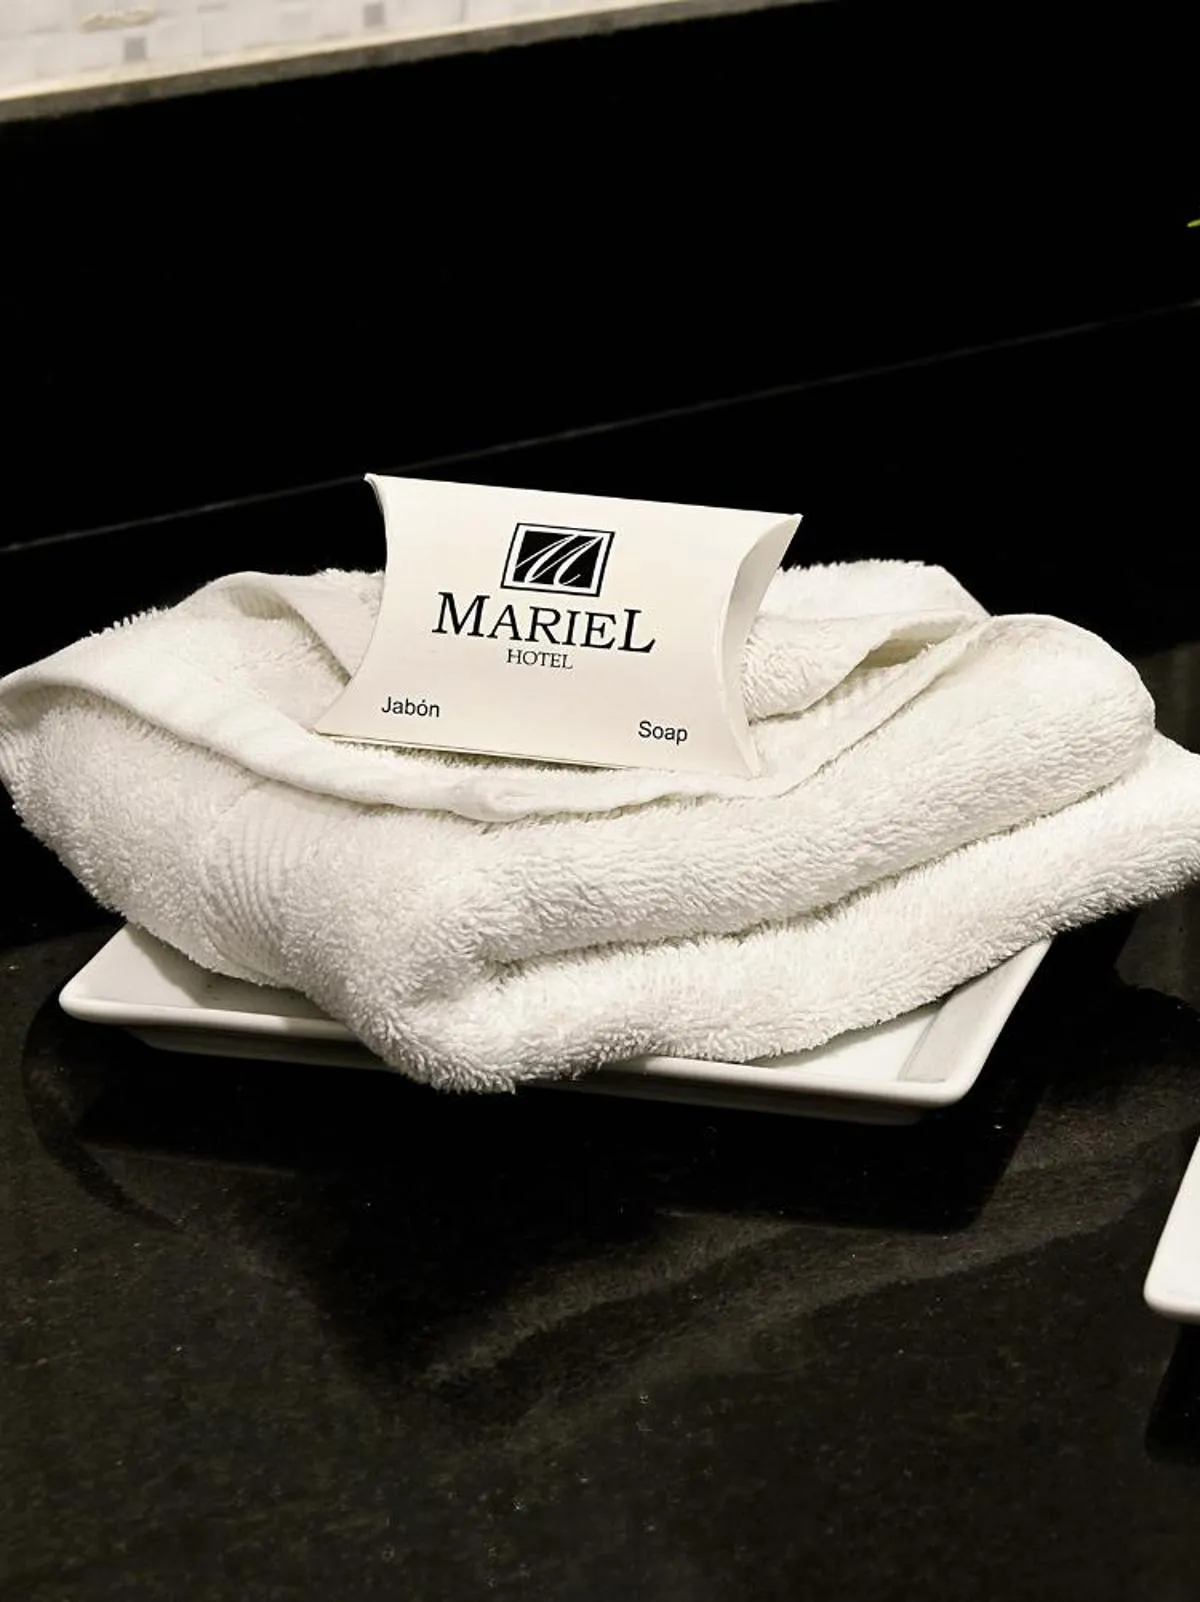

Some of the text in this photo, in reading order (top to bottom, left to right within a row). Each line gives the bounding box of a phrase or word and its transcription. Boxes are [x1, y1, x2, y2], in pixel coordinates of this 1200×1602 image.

[430, 591, 657, 655] MARIEL
[505, 648, 574, 671] HOTEL
[380, 696, 441, 719] Jabón
[637, 719, 689, 747] Soap
